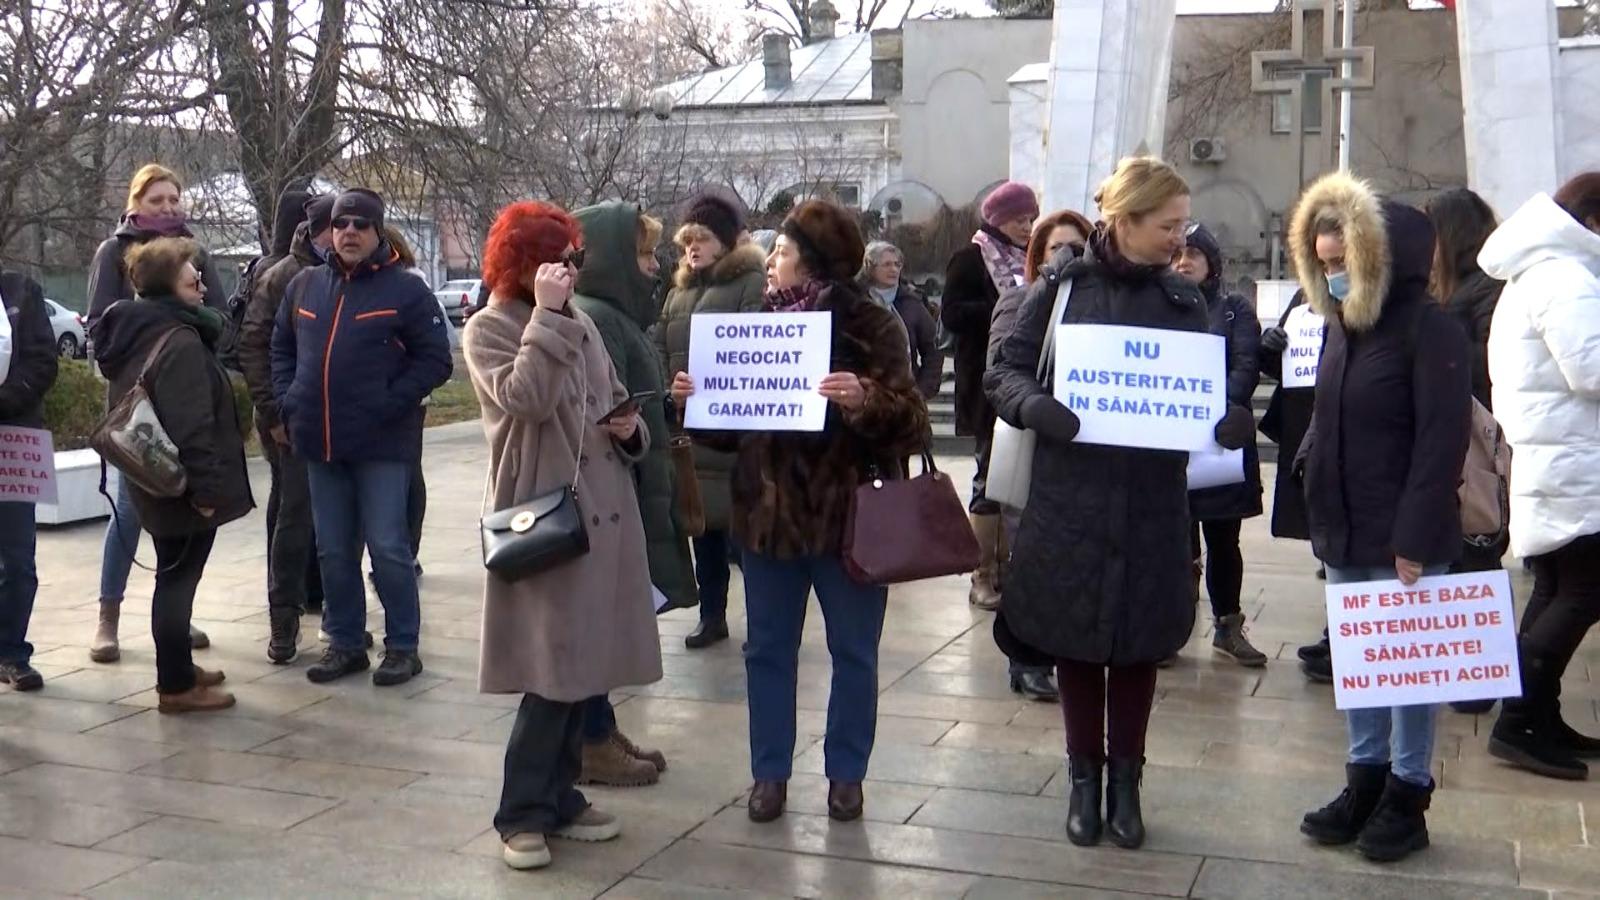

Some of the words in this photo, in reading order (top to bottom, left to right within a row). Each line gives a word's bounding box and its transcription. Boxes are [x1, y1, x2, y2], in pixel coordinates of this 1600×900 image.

[714, 324, 807, 338] CONTRACT
[715, 351, 802, 364] NEGOCIAT
[1124, 340, 1160, 359] NU
[704, 377, 812, 390] MULTIANUAL
[1067, 368, 1213, 393] AUSTERITATE
[708, 402, 803, 416] GARANTAT!
[1069, 392, 1090, 409] ÎN
[1097, 396, 1211, 420] SĂNĂTATE!
[22, 452, 41, 462] CU
[31, 470, 48, 480] LA
[1343, 594, 1370, 609] MF
[1378, 590, 1431, 607] ESTE
[1438, 584, 1495, 602] BAZA
[1339, 613, 1467, 637] SISTEMULUI
[1474, 611, 1502, 626] DE
[1364, 640, 1483, 662] SĂNĂTATE!
[1342, 675, 1370, 689] NU
[1457, 664, 1510, 681] ACID!
